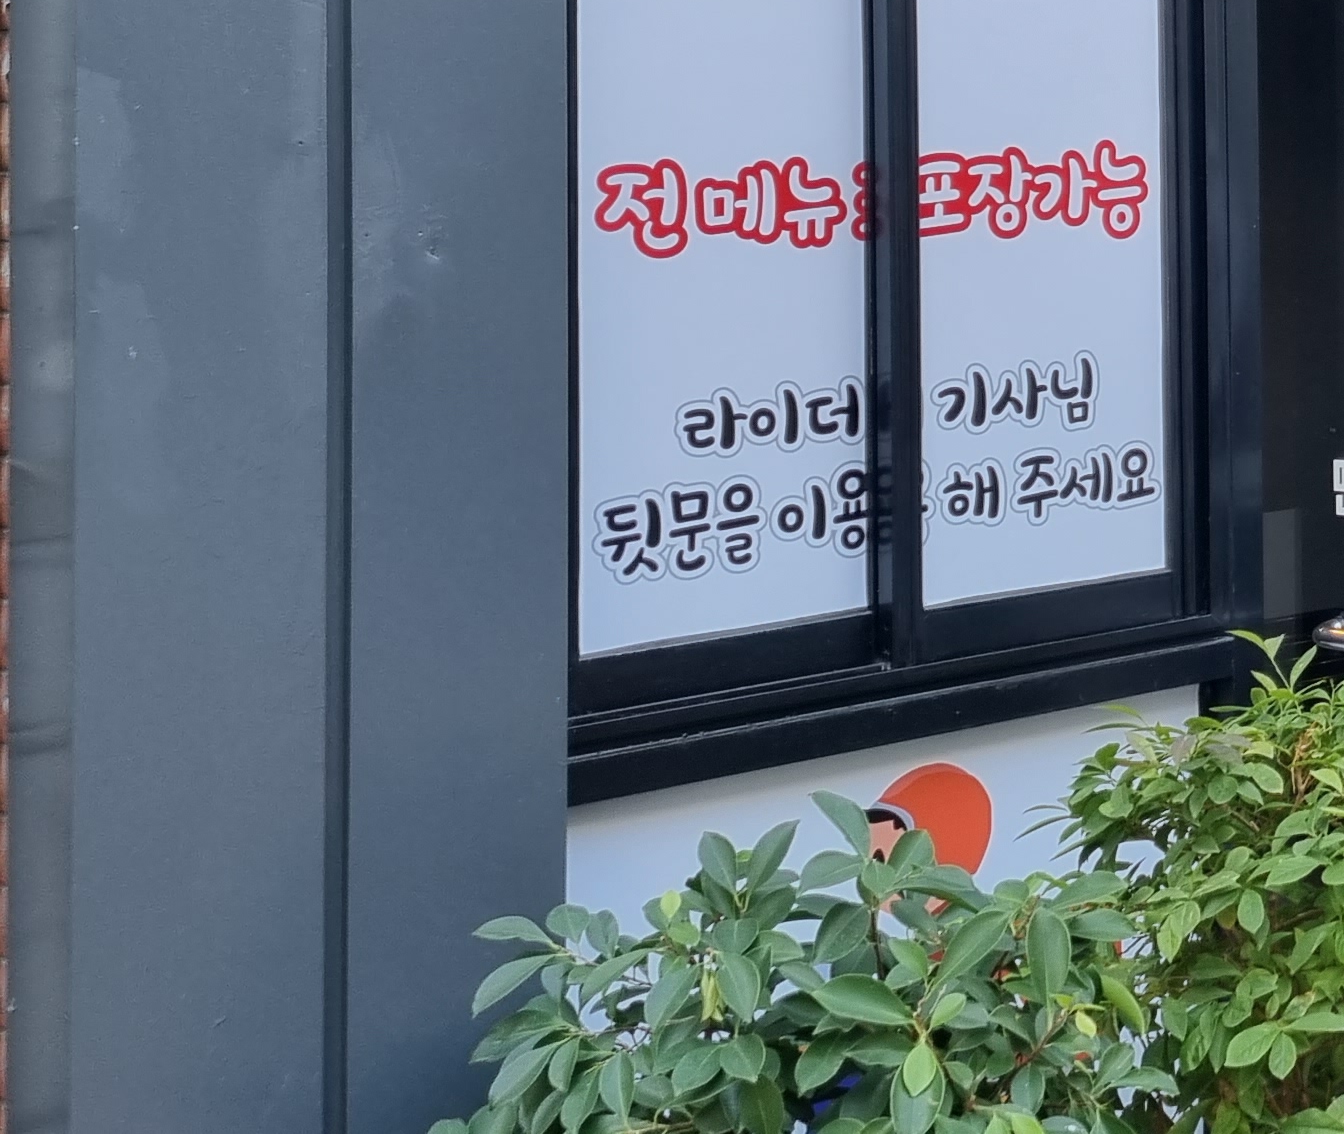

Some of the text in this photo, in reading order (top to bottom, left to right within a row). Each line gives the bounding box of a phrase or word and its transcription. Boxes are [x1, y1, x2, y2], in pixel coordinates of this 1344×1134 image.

[936, 354, 1096, 429] 기사님
[599, 482, 762, 576] 뒷문을
[1015, 449, 1160, 516] 주세요
